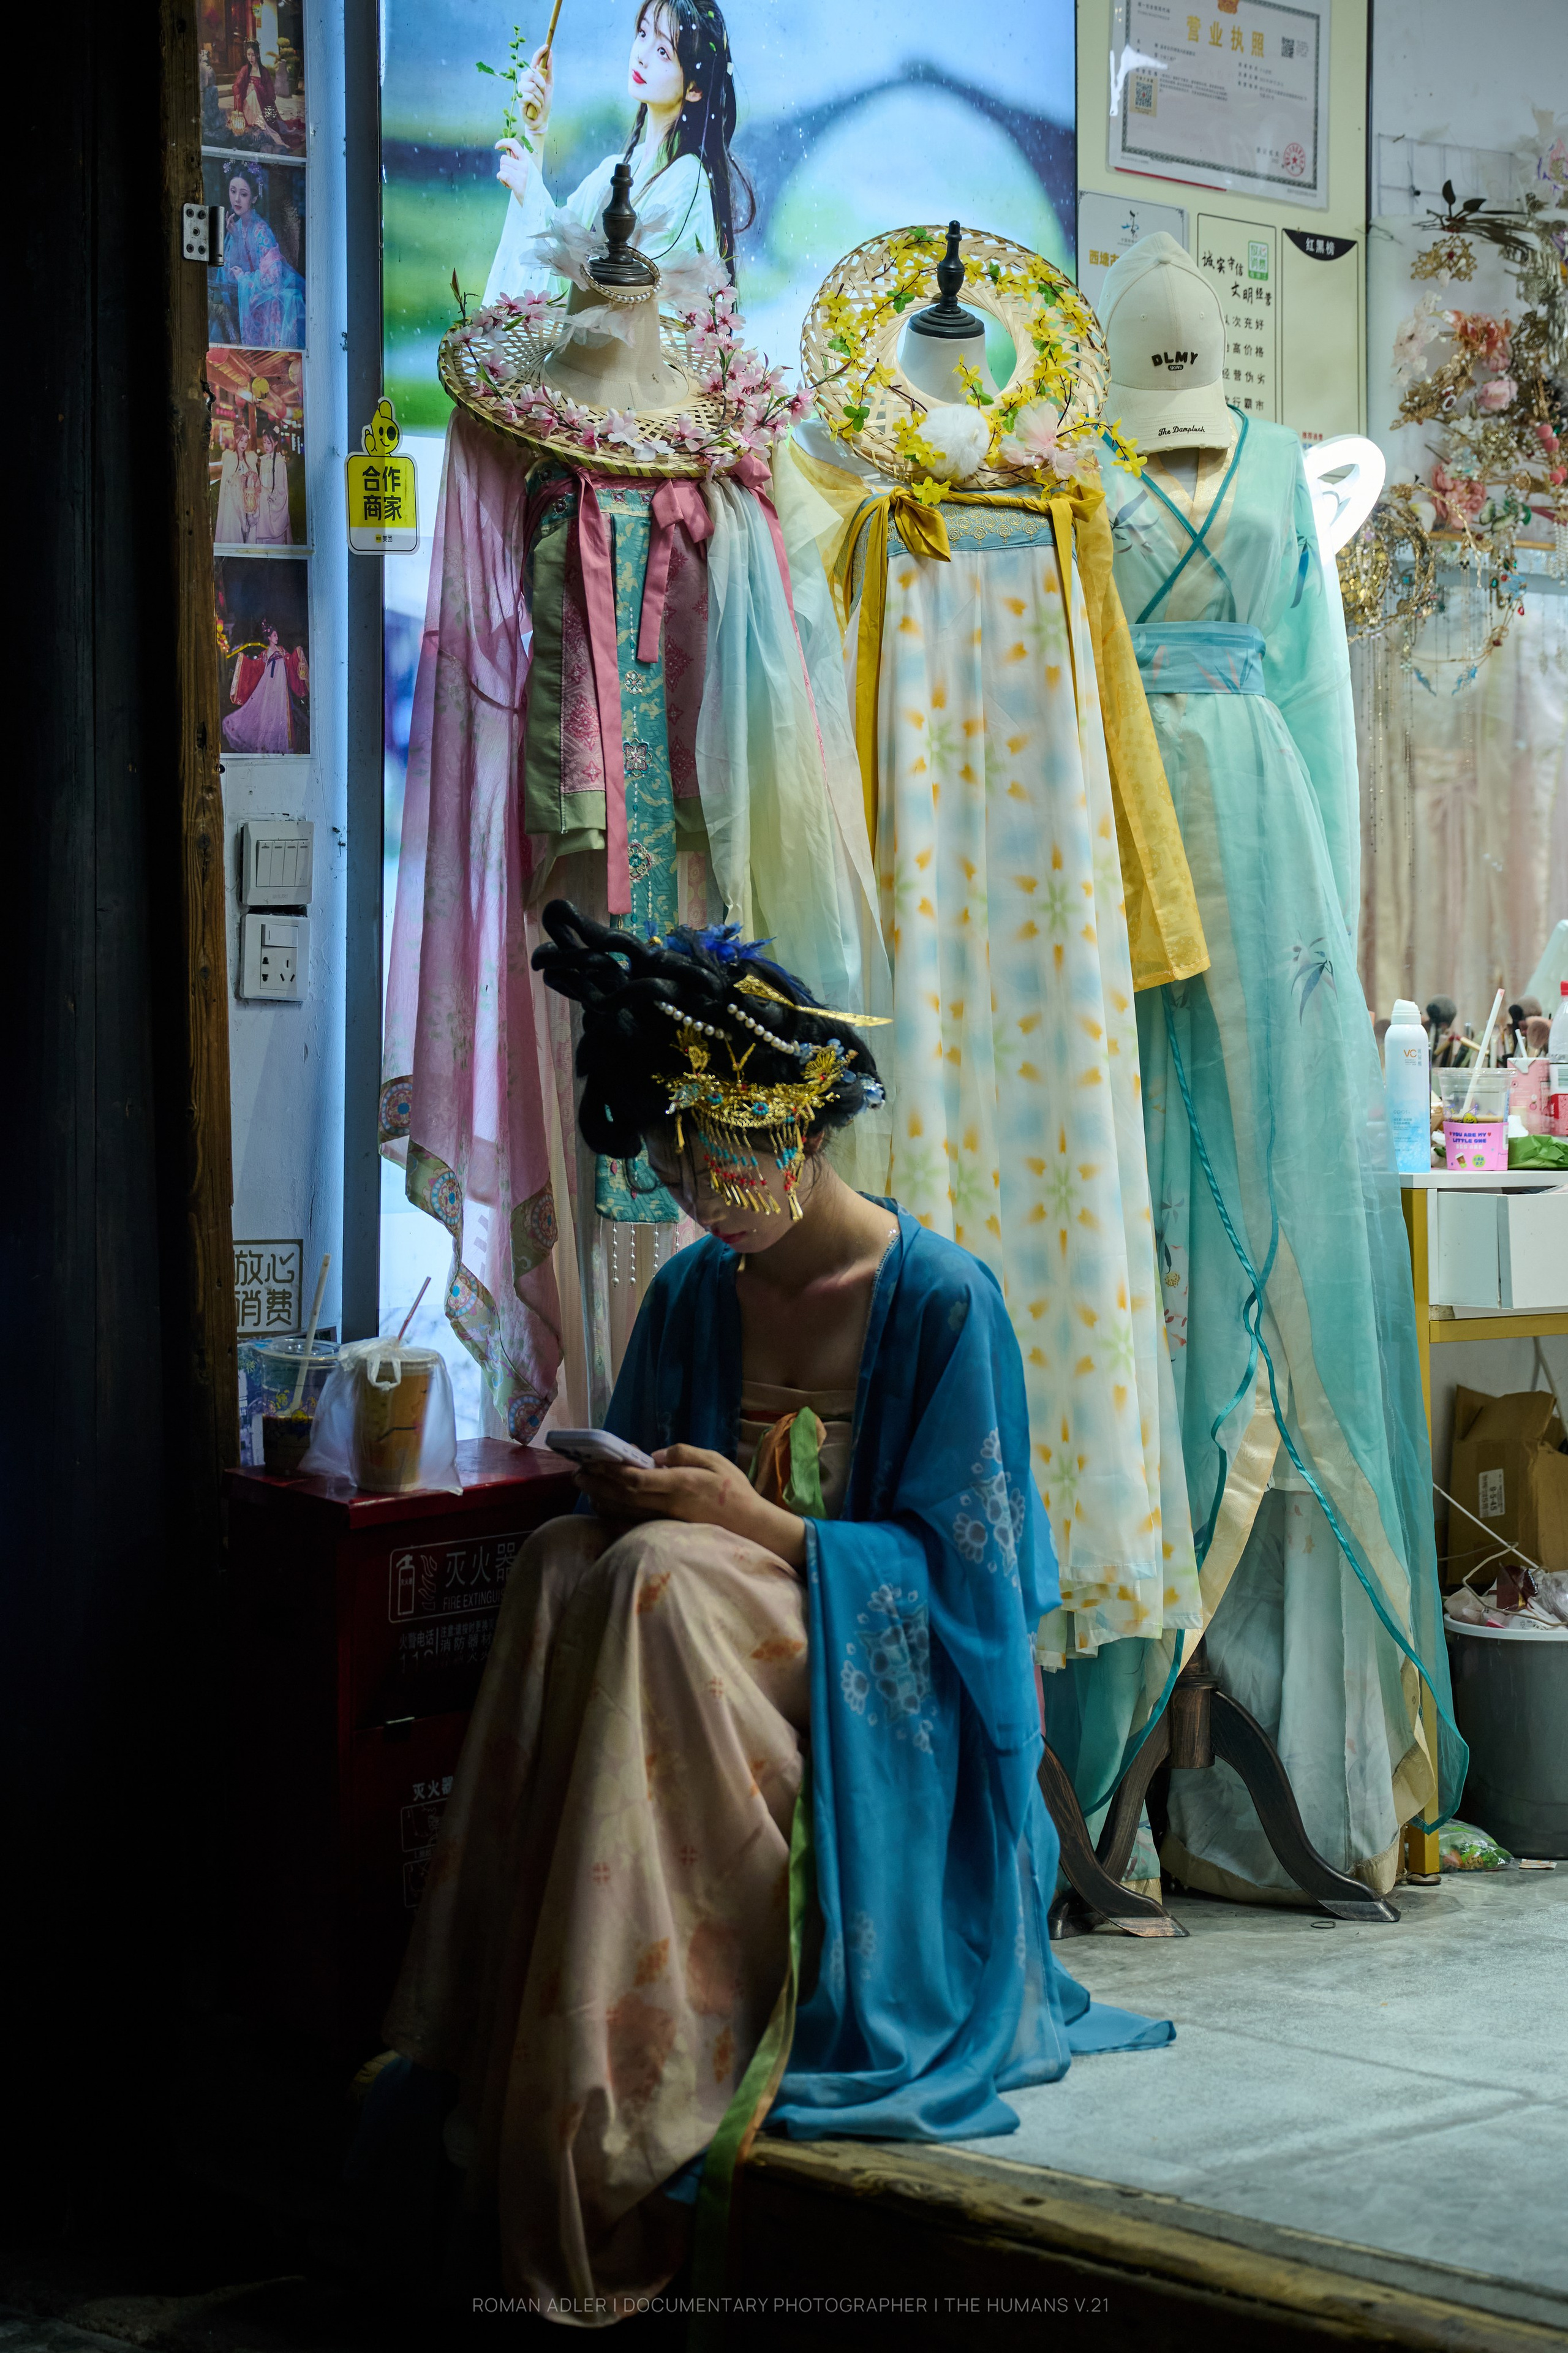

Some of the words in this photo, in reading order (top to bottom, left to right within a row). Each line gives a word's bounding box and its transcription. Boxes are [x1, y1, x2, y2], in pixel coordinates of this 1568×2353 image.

[1187, 15, 1264, 58] 营业执照
[1305, 238, 1335, 256] 红黑榜
[1202, 251, 1243, 276] 诚实守信
[1231, 281, 1272, 306] 文明经营
[1152, 351, 1198, 366] DLMY
[1158, 428, 1171, 436] The
[362, 466, 401, 492] 合作
[363, 495, 402, 521] 商家
[1403, 1049, 1417, 1058] VC
[235, 1250, 295, 1285] 放心
[235, 1289, 292, 1326] 消费
[446, 1542, 516, 1588] 灭火器
[443, 1594, 461, 1611] FIRE
[399, 1628, 434, 1650] 火警电话
[440, 1633, 492, 1653] 消防器材
[412, 1775, 453, 1801] 灭火器
